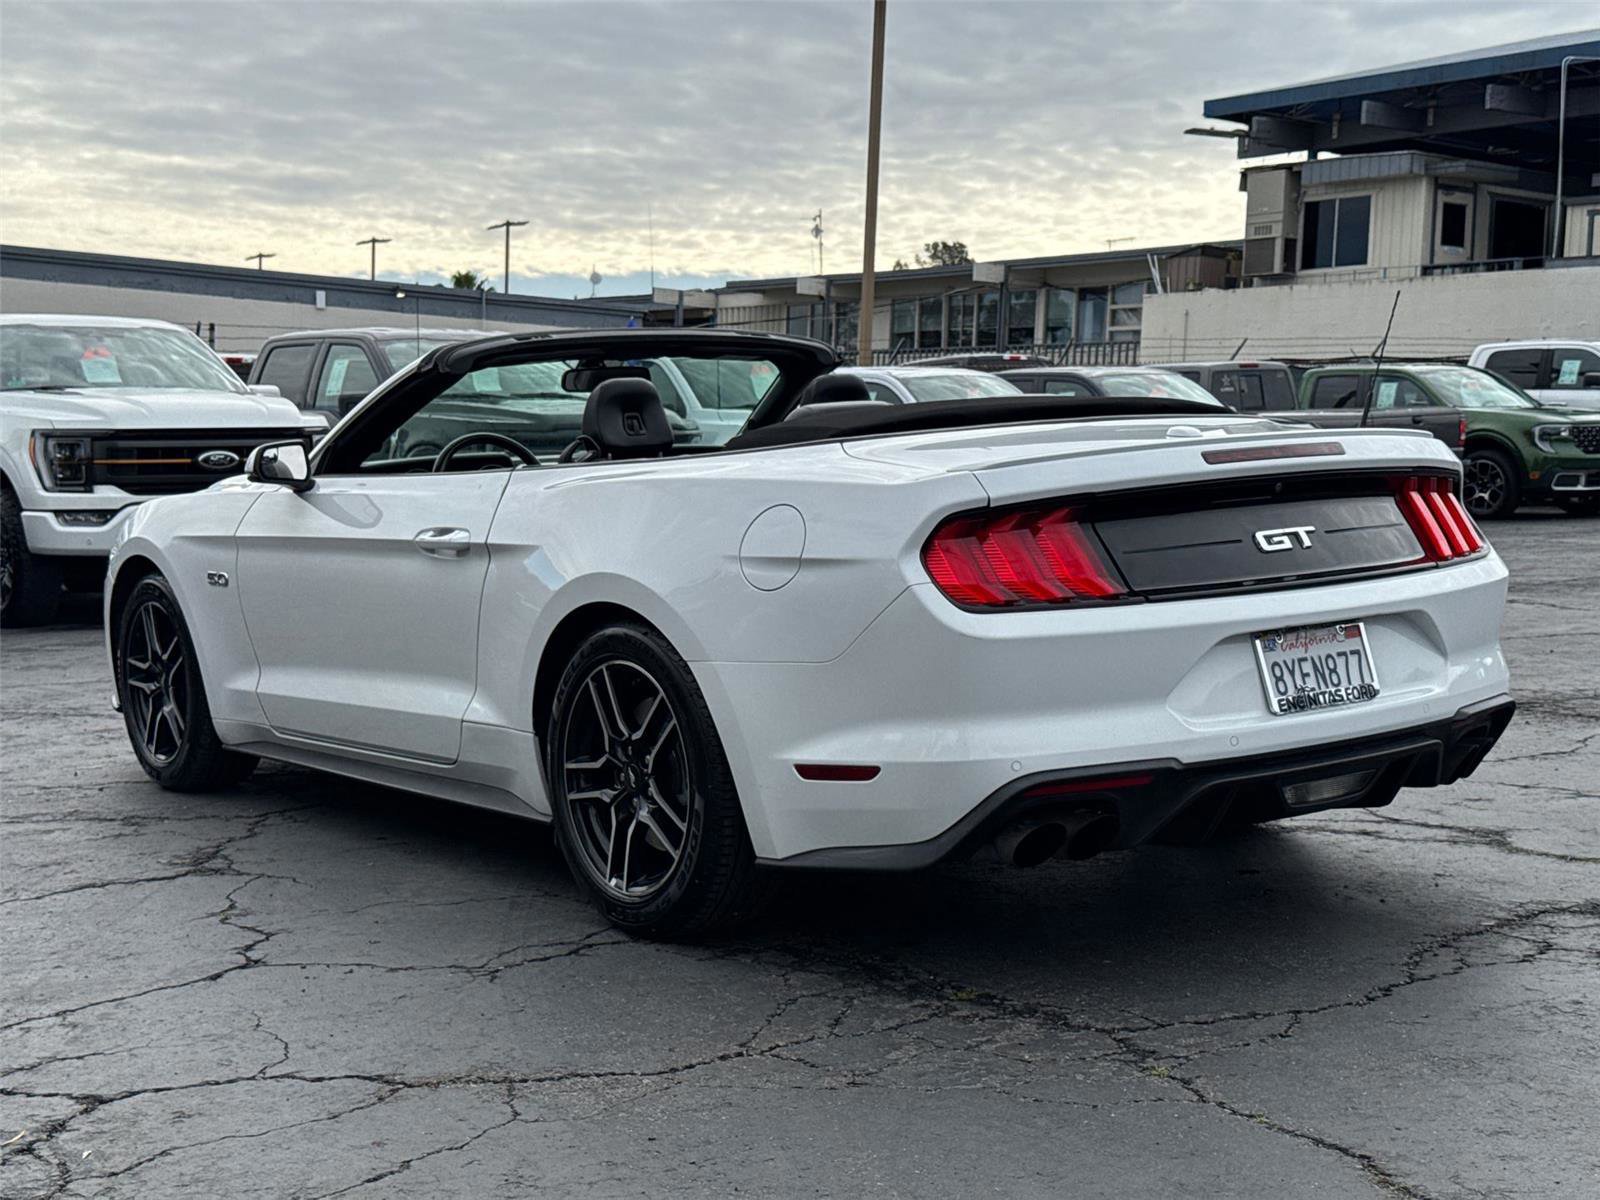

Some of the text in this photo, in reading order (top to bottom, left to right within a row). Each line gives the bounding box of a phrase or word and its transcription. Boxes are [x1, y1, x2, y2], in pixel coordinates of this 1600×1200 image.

[1254, 526, 1316, 553] GT
[1281, 631, 1344, 653] California
[1345, 683, 1378, 701] FORD
